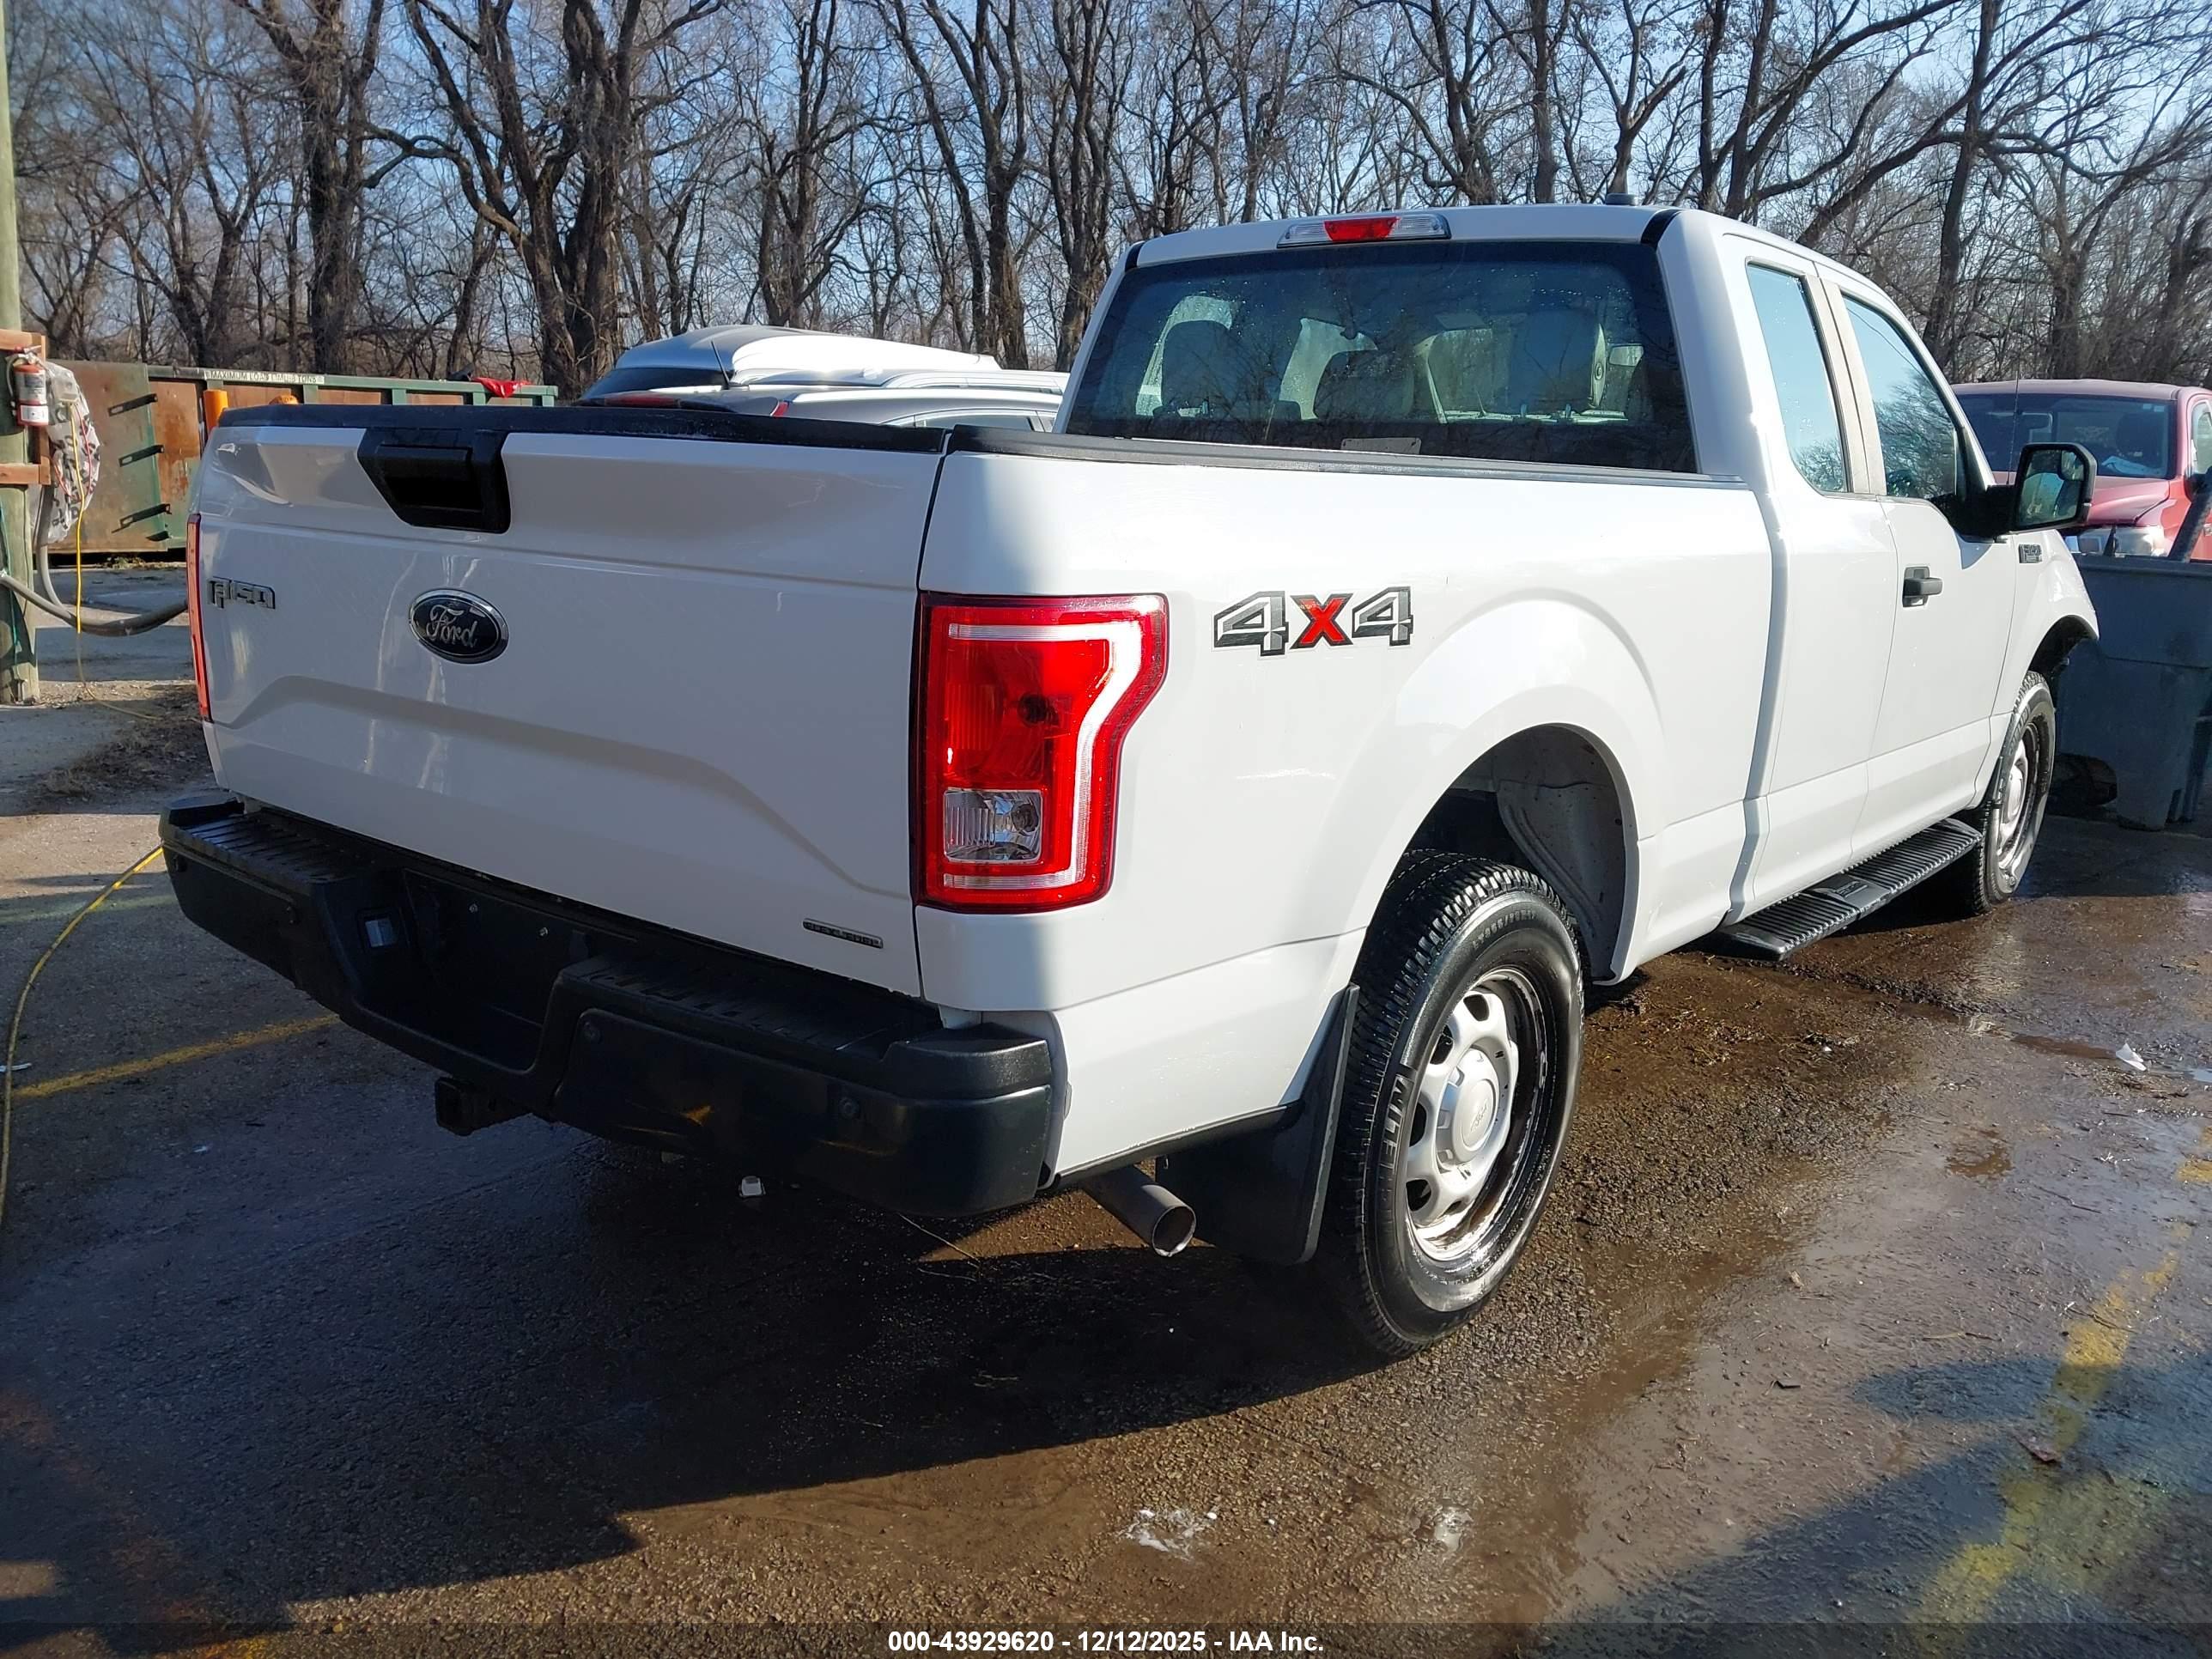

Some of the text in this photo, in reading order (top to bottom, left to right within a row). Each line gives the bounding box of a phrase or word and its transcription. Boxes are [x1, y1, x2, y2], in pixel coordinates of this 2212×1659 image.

[211, 369, 248, 380] MAXIMUM
[250, 371, 270, 380] LOAD
[296, 374, 318, 383] TONS
[426, 605, 478, 648] Ford
